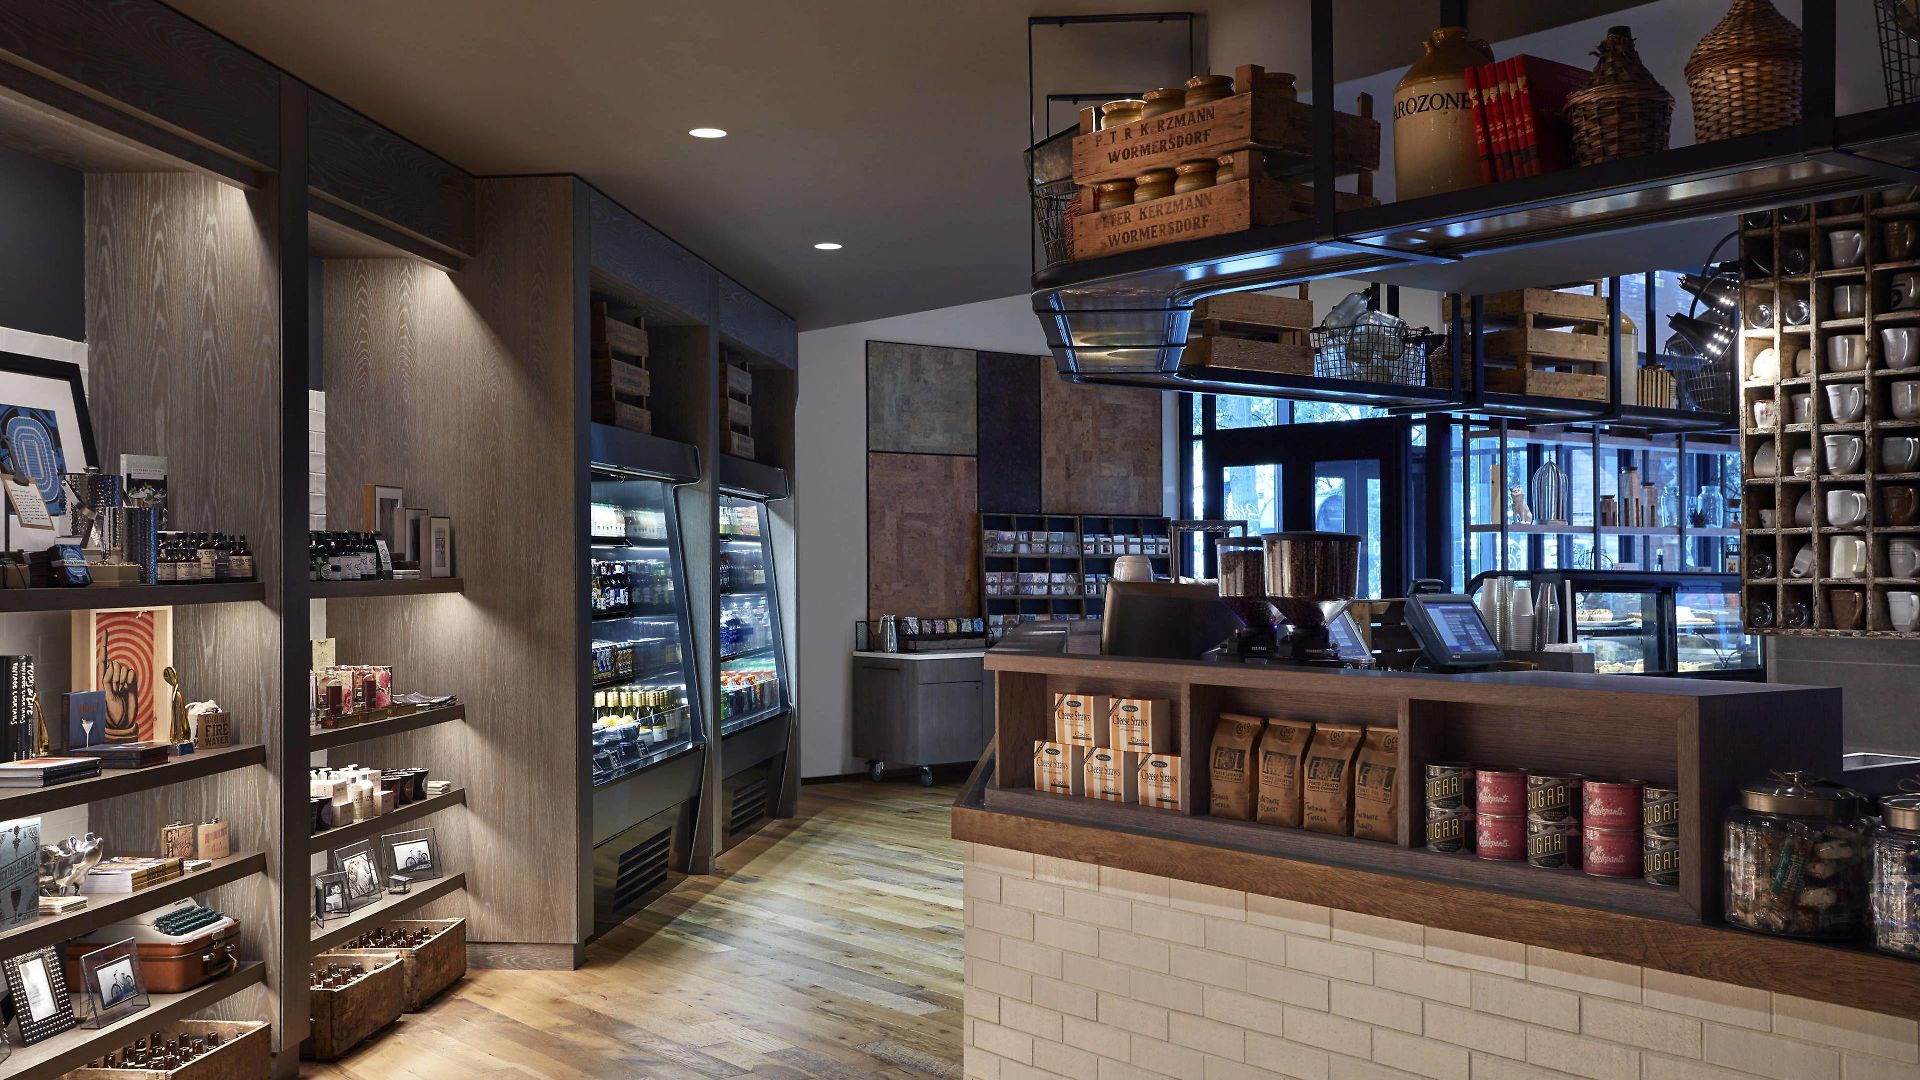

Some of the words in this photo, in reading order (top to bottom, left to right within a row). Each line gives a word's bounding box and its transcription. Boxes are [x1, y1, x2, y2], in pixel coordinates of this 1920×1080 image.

[1095, 127, 1132, 147] PTR
[1140, 106, 1215, 137] KRZMANN
[1108, 128, 1212, 164] WORMERSDORF
[1140, 192, 1212, 220] KERZMANN
[1108, 214, 1210, 247] WORMERSDORF
[205, 723, 228, 737] FIRE
[1112, 715, 1130, 725] Cheese
[1130, 715, 1148, 727] Straws
[205, 736, 229, 746] WATER
